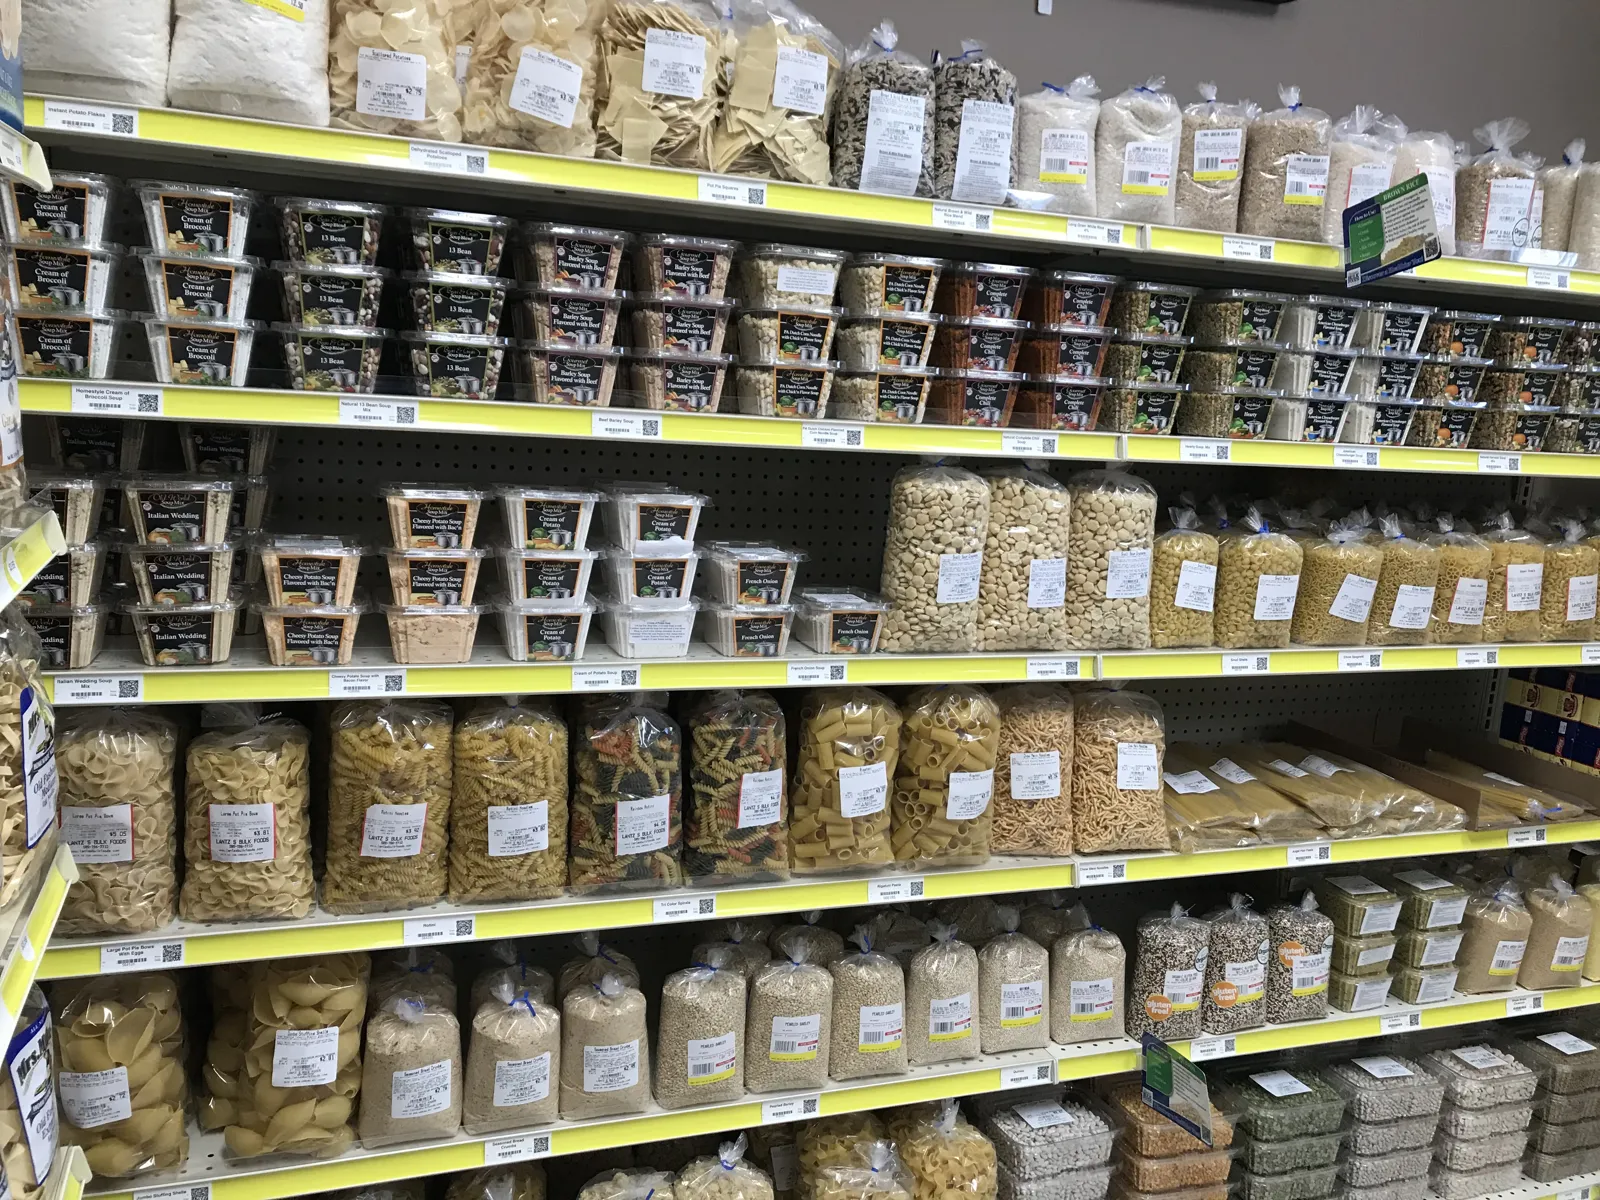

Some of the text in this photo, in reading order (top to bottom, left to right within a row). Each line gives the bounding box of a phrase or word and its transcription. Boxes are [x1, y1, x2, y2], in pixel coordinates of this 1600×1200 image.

[1383, 179, 1419, 201] BROWN RICE
[34, 203, 57, 211] Cream
[569, 255, 584, 263] Barley
[559, 260, 580, 270] Flavored
[177, 572, 205, 580] Wedding
[1151, 1007, 1170, 1015] free!
[16, 1050, 40, 1086] Mrs.
